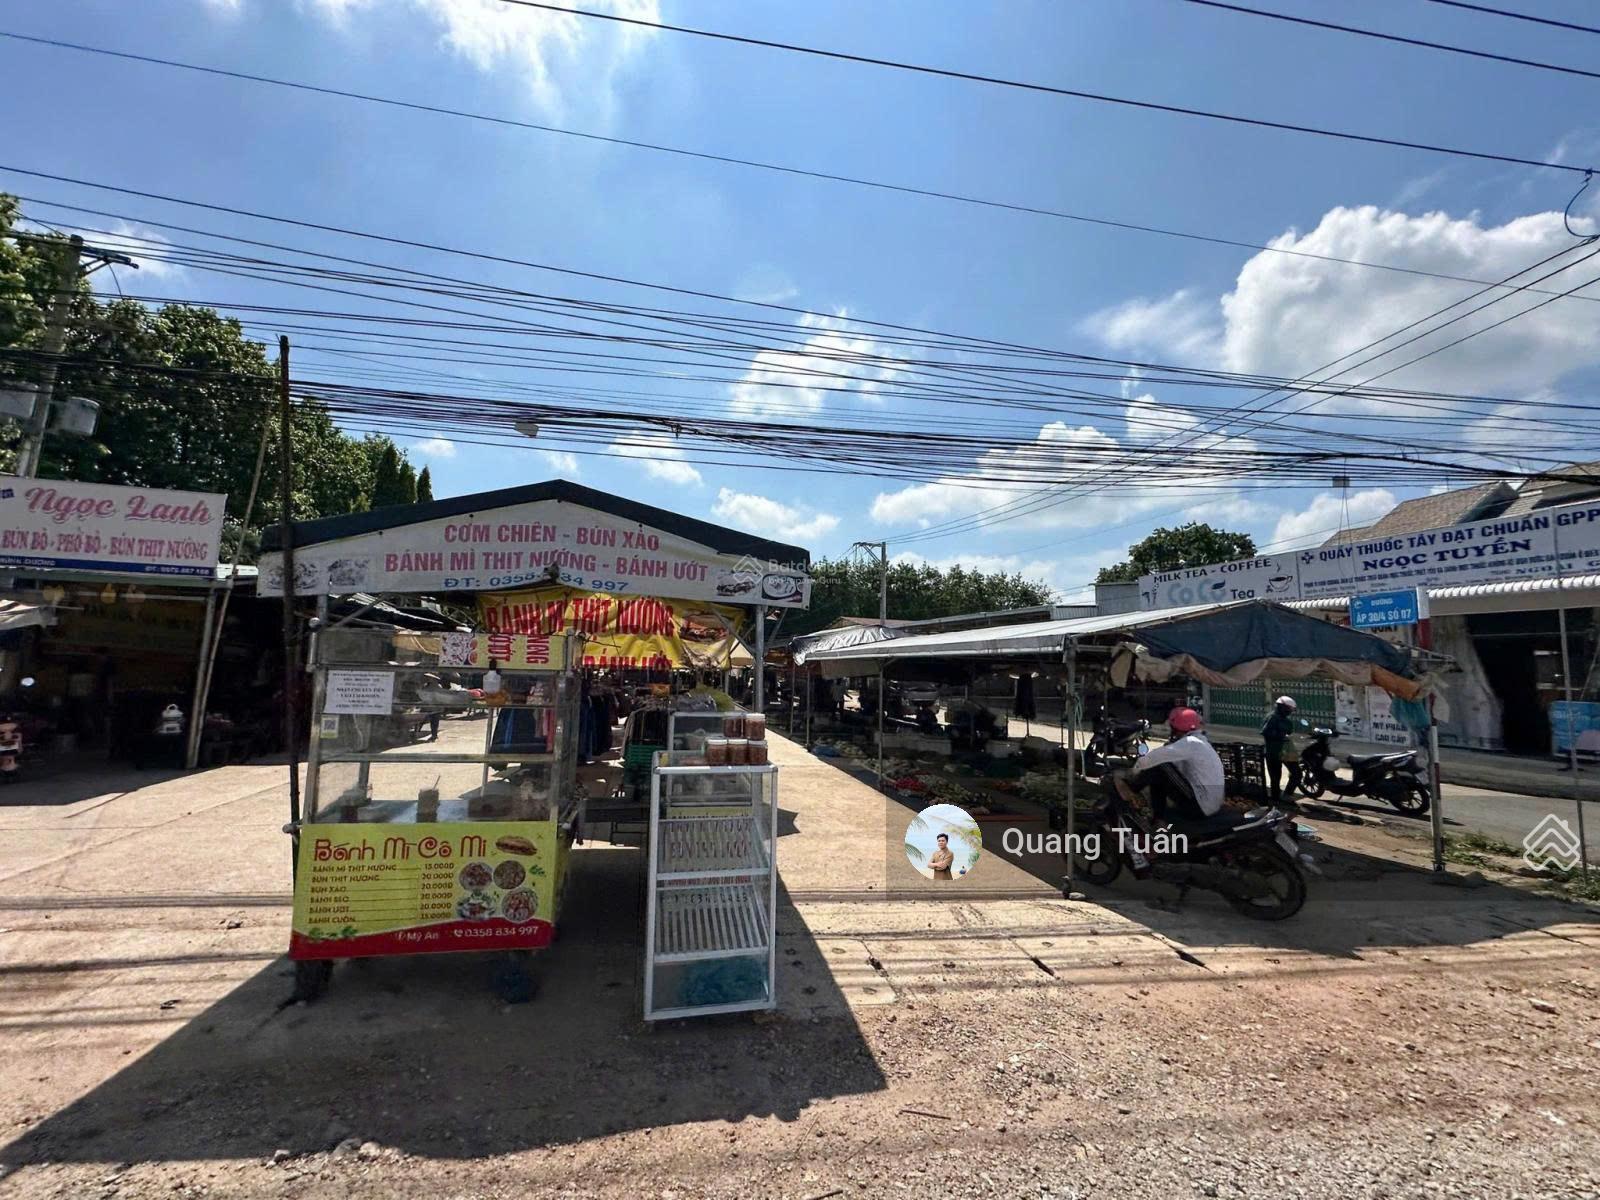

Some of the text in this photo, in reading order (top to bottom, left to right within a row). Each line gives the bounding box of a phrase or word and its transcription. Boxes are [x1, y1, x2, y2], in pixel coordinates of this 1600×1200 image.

[444, 521, 490, 543] CƠM
[497, 521, 557, 543] CHIÊN
[576, 525, 616, 546] BÚN
[1357, 536, 1403, 556] THUỐC
[1408, 533, 1437, 549] TÂY
[1442, 528, 1475, 543] ĐẠT
[1556, 508, 1600, 526] GPP
[385, 549, 443, 572] BÁNH
[450, 549, 475, 571] MÌ
[482, 551, 524, 574] THỊT
[616, 555, 668, 578] BÁNH
[673, 560, 708, 582] ƯỚT
[1363, 553, 1427, 571] NGỌC
[1434, 536, 1532, 562] TUYỀN
[1153, 571, 1181, 584] MILK
[1186, 567, 1208, 579] TEA
[1220, 558, 1272, 573] COFFEE
[592, 579, 629, 591] 997
[1230, 588, 1255, 600] Tea
[314, 839, 375, 861] Bánh
[418, 836, 452, 859] Cô
[519, 926, 539, 935] 997
